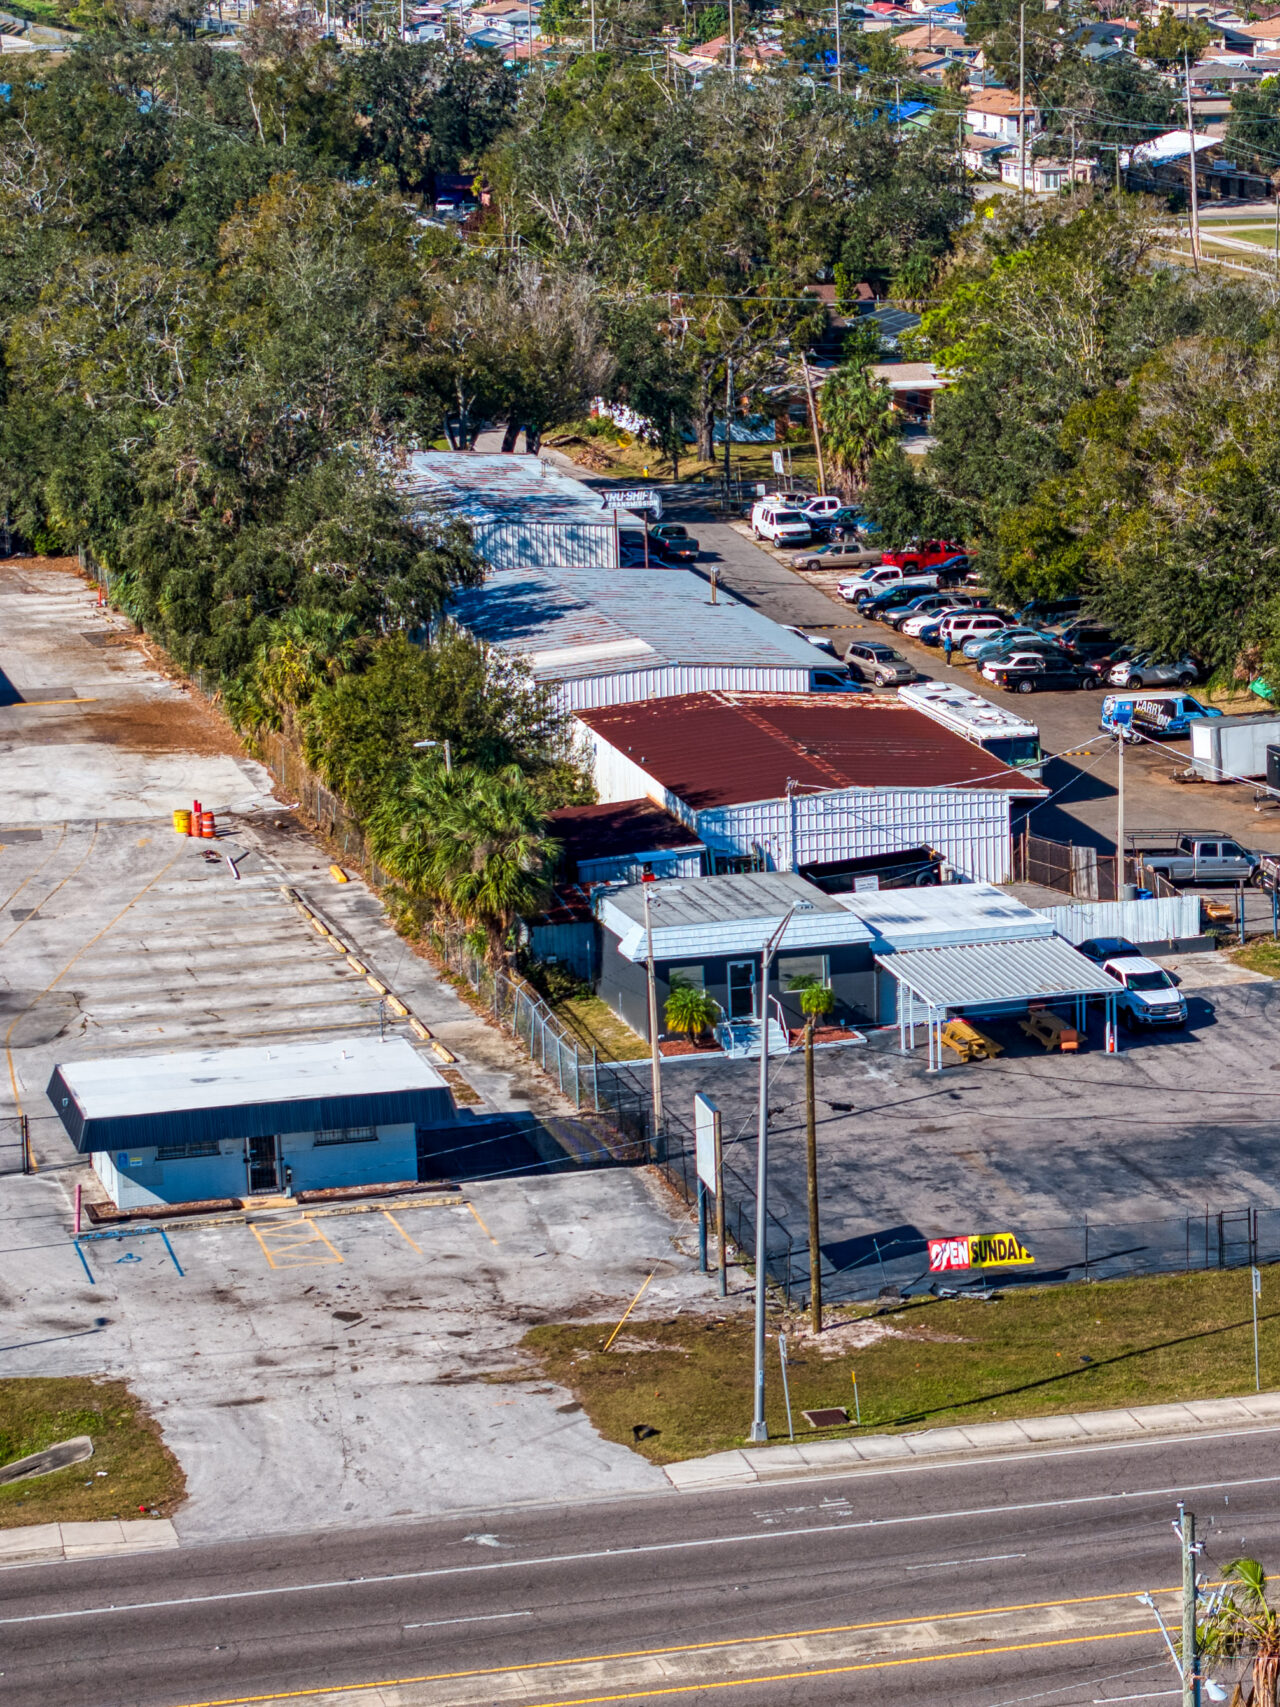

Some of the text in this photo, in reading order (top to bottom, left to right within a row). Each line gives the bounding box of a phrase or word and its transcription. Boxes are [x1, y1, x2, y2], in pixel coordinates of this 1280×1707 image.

[1135, 700, 1164, 716] CARRY
[930, 1237, 1032, 1270] OPEN SUNDAY
